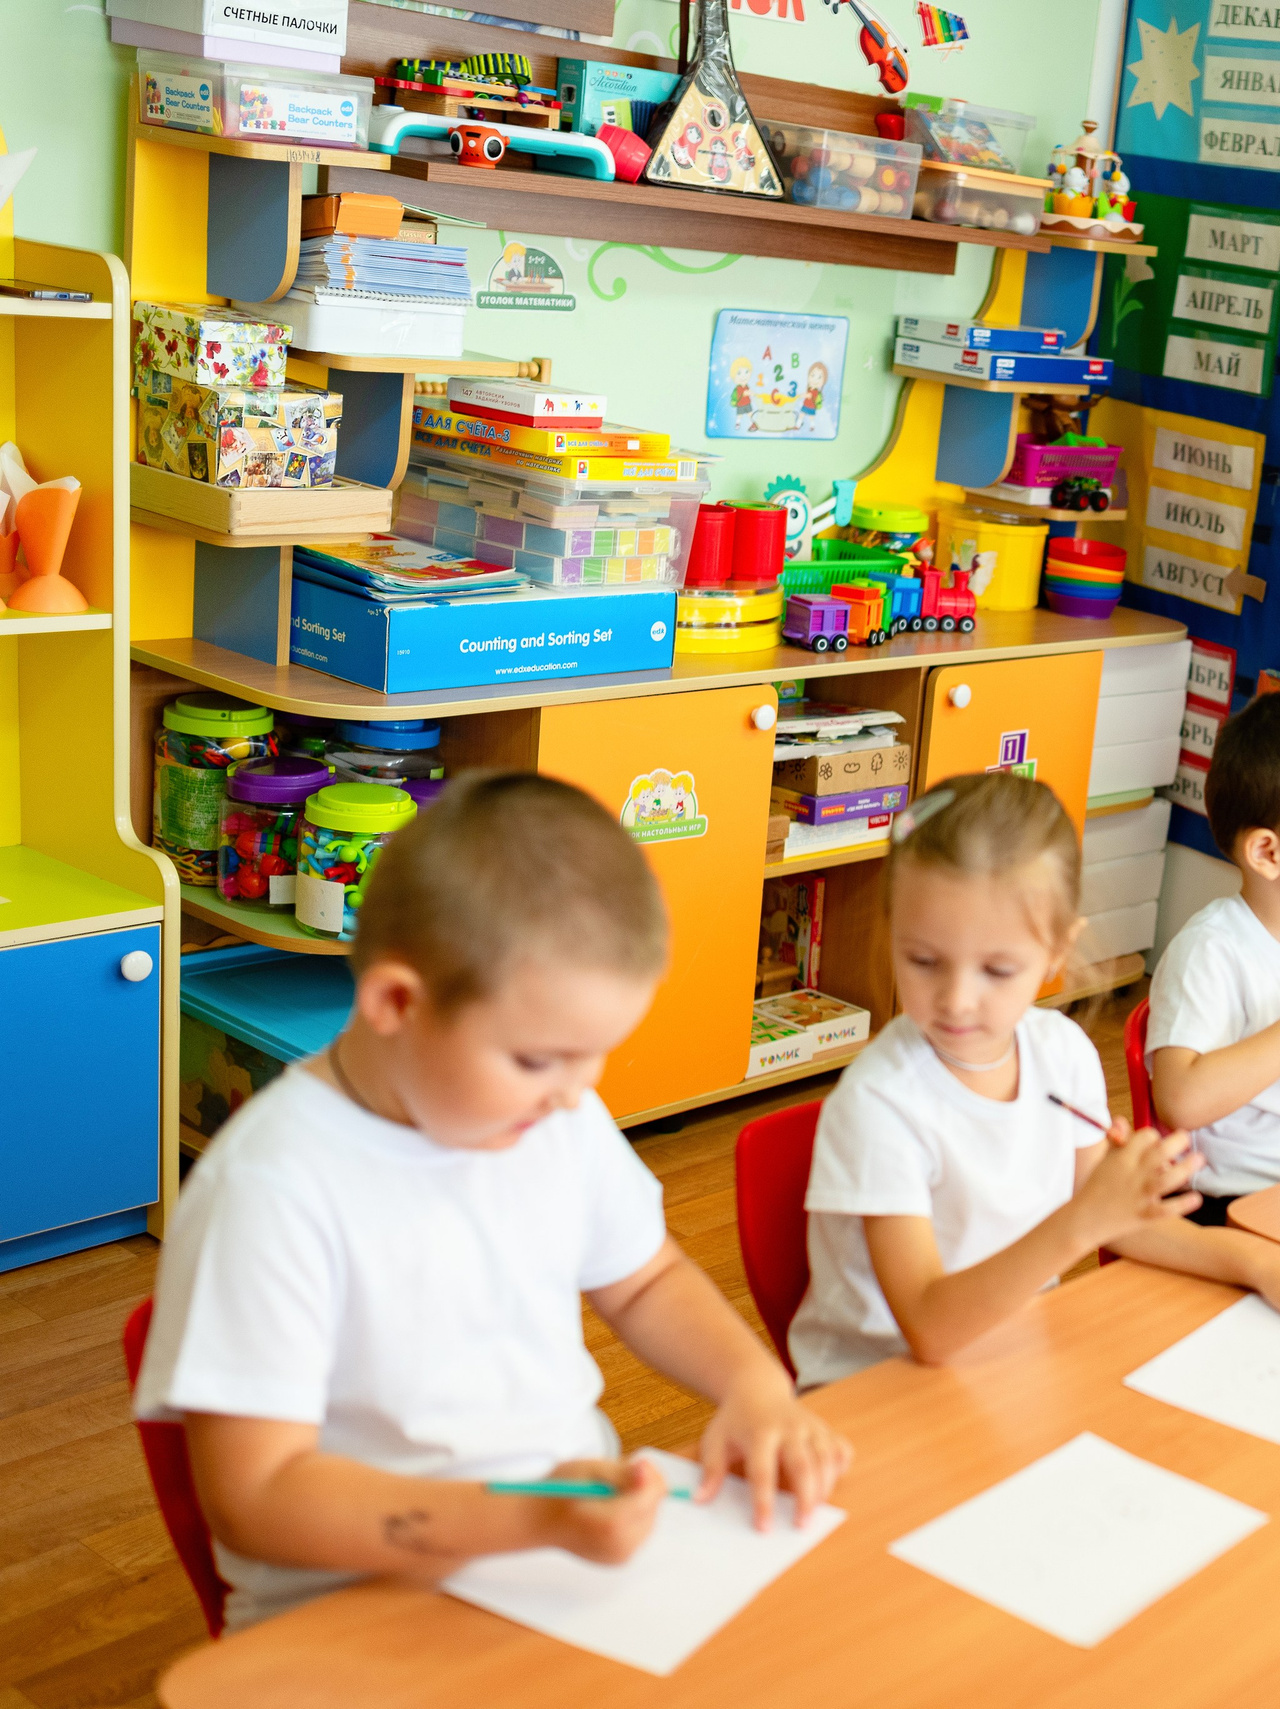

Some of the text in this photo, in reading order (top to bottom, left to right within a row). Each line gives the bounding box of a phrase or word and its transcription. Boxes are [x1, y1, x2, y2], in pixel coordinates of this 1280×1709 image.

[223, 6, 338, 35] СЧЕТНЫЕ ПАЛОЧКИ
[589, 75, 637, 92] Accordion
[165, 86, 195, 99] Backpack
[165, 97, 210, 113] Bear Counters
[288, 103, 333, 117] Backpack
[288, 114, 353, 129] Bear Counters
[1208, 229, 1263, 257] МАРТ
[480, 295, 573, 307] УГОЛОК МАТЕМАТИКИ
[1185, 290, 1264, 321] АПРЕЛЬ
[728, 315, 807, 330] Математический
[773, 364, 784, 382] 2
[1193, 351, 1241, 378] МАЙ
[756, 373, 764, 387] 1
[462, 388, 473, 397] 147
[475, 389, 505, 399] АВТОРСКИХ
[787, 381, 798, 398] 3
[425, 413, 452, 430] ДЛЯ
[456, 419, 511, 442] СЧЁТА-3
[435, 436, 458, 450] ДЛЯ
[1172, 441, 1233, 476] ИЮНЬ
[1164, 502, 1226, 536] ИЮЛЬ
[291, 616, 346, 643] nd Sorting Set
[459, 628, 613, 654] Counting and Sorting Set
[495, 661, 578, 675] www.edxeducation.com
[1007, 740, 1013, 760] 1
[641, 825, 687, 837] НАСТОЛЬНЫХ
[688, 823, 702, 831] ИГР
[817, 1025, 857, 1045] ТОМИК
[760, 1047, 800, 1067] ТОМИК
